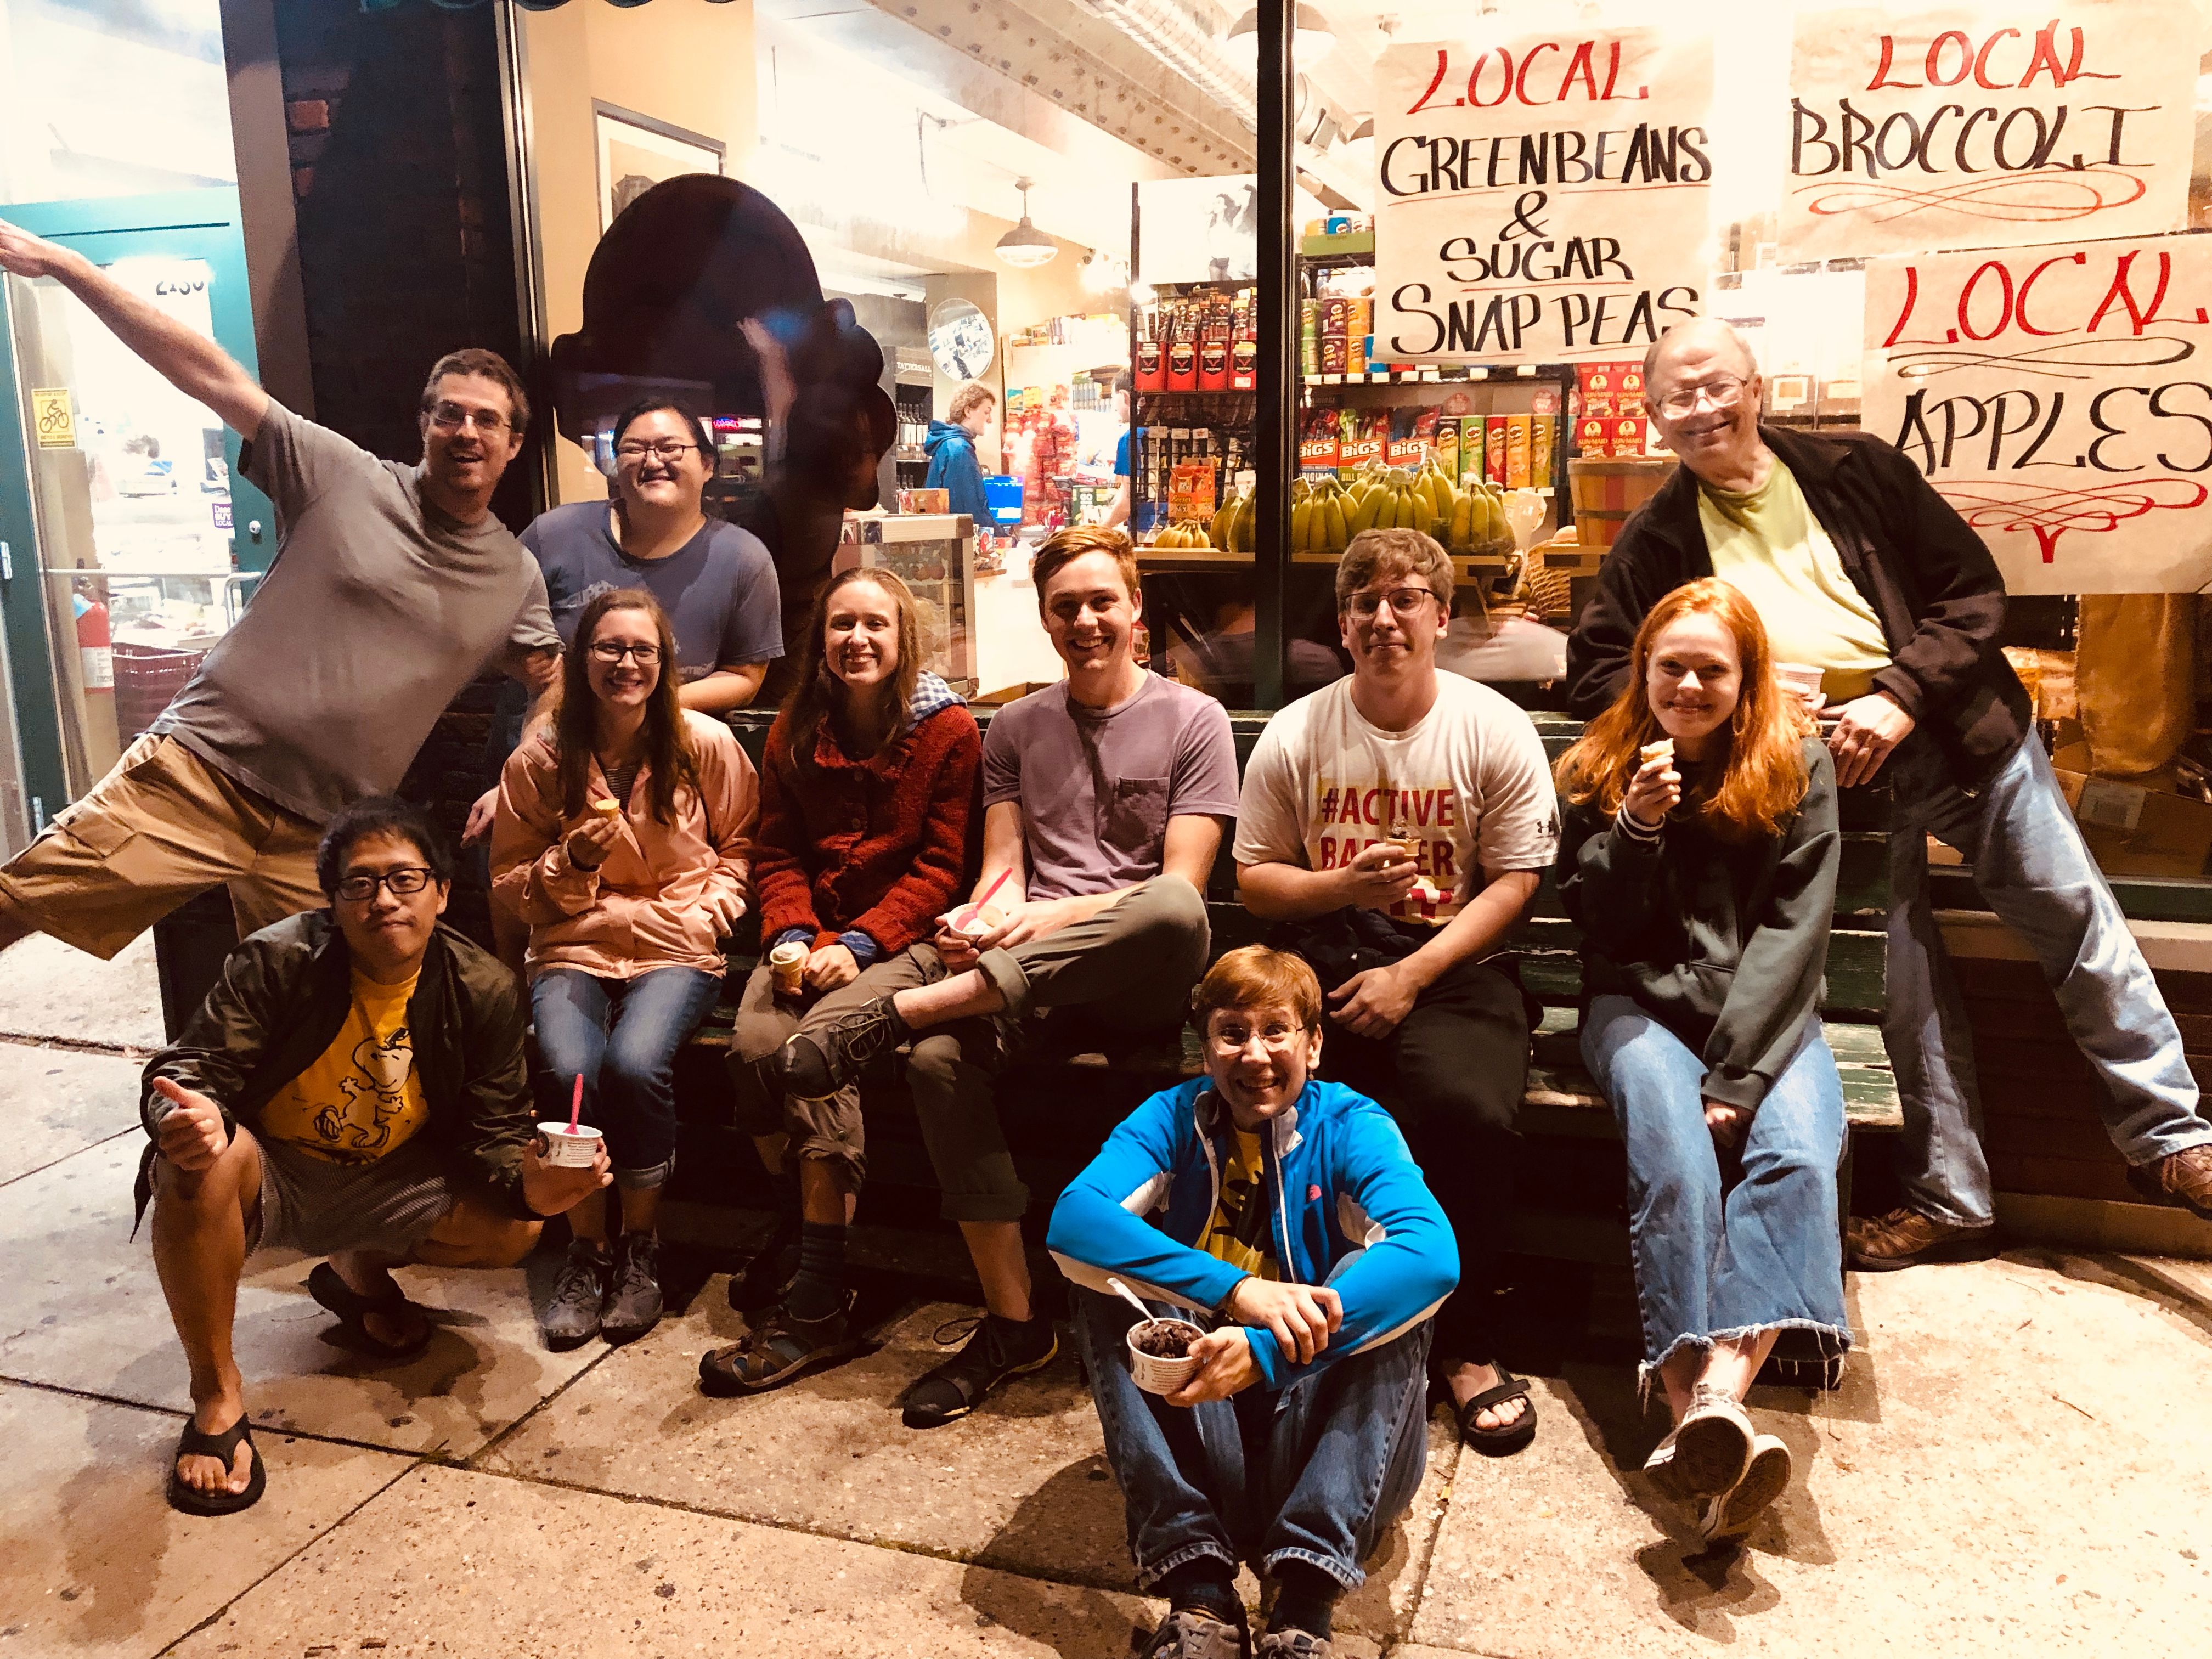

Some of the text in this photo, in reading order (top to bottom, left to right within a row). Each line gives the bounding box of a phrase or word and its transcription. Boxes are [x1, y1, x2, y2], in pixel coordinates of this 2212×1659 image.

[1407, 40, 1649, 115] LOCAL
[1866, 18, 2121, 90] LOCAL
[1791, 97, 2161, 179] BROCCOLI
[1499, 190, 1550, 242] &
[1439, 236, 1635, 282] SUGAR
[1391, 283, 1699, 354] SNAP PEAS
[1883, 250, 2209, 347] LOCAL
[1895, 382, 2212, 476] APPLES
[1322, 788, 1454, 826] #ACTIVE
[1321, 837, 1455, 877] BAER
